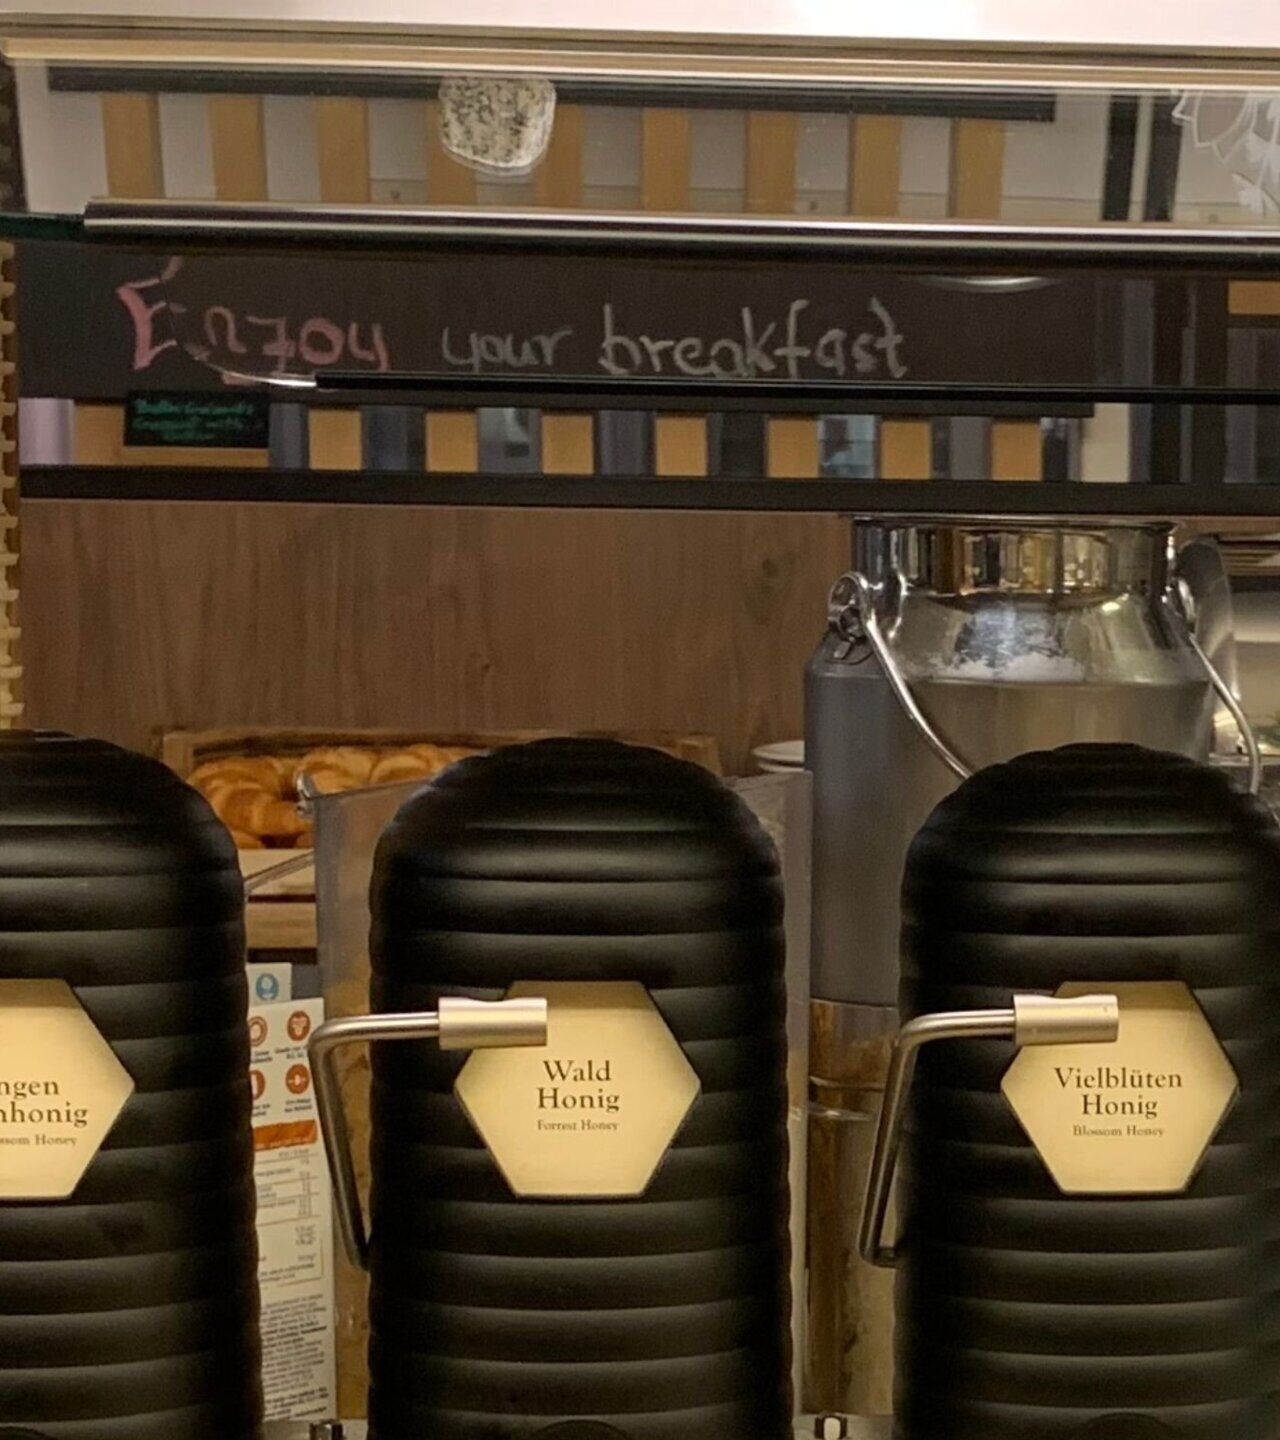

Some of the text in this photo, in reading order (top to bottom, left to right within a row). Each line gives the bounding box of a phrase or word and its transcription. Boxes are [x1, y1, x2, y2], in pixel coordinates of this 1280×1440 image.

[441, 323, 573, 374] your
[598, 298, 909, 380] breakfast
[543, 1059, 611, 1082] Wald
[1054, 1067, 1183, 1089] Vielblüten
[536, 1086, 621, 1112] Honig
[1081, 1093, 1159, 1120] Honig
[580, 1119, 619, 1132] Honey
[1072, 1125, 1165, 1137] Blossom Honey
[34, 1133, 78, 1147] Honey
